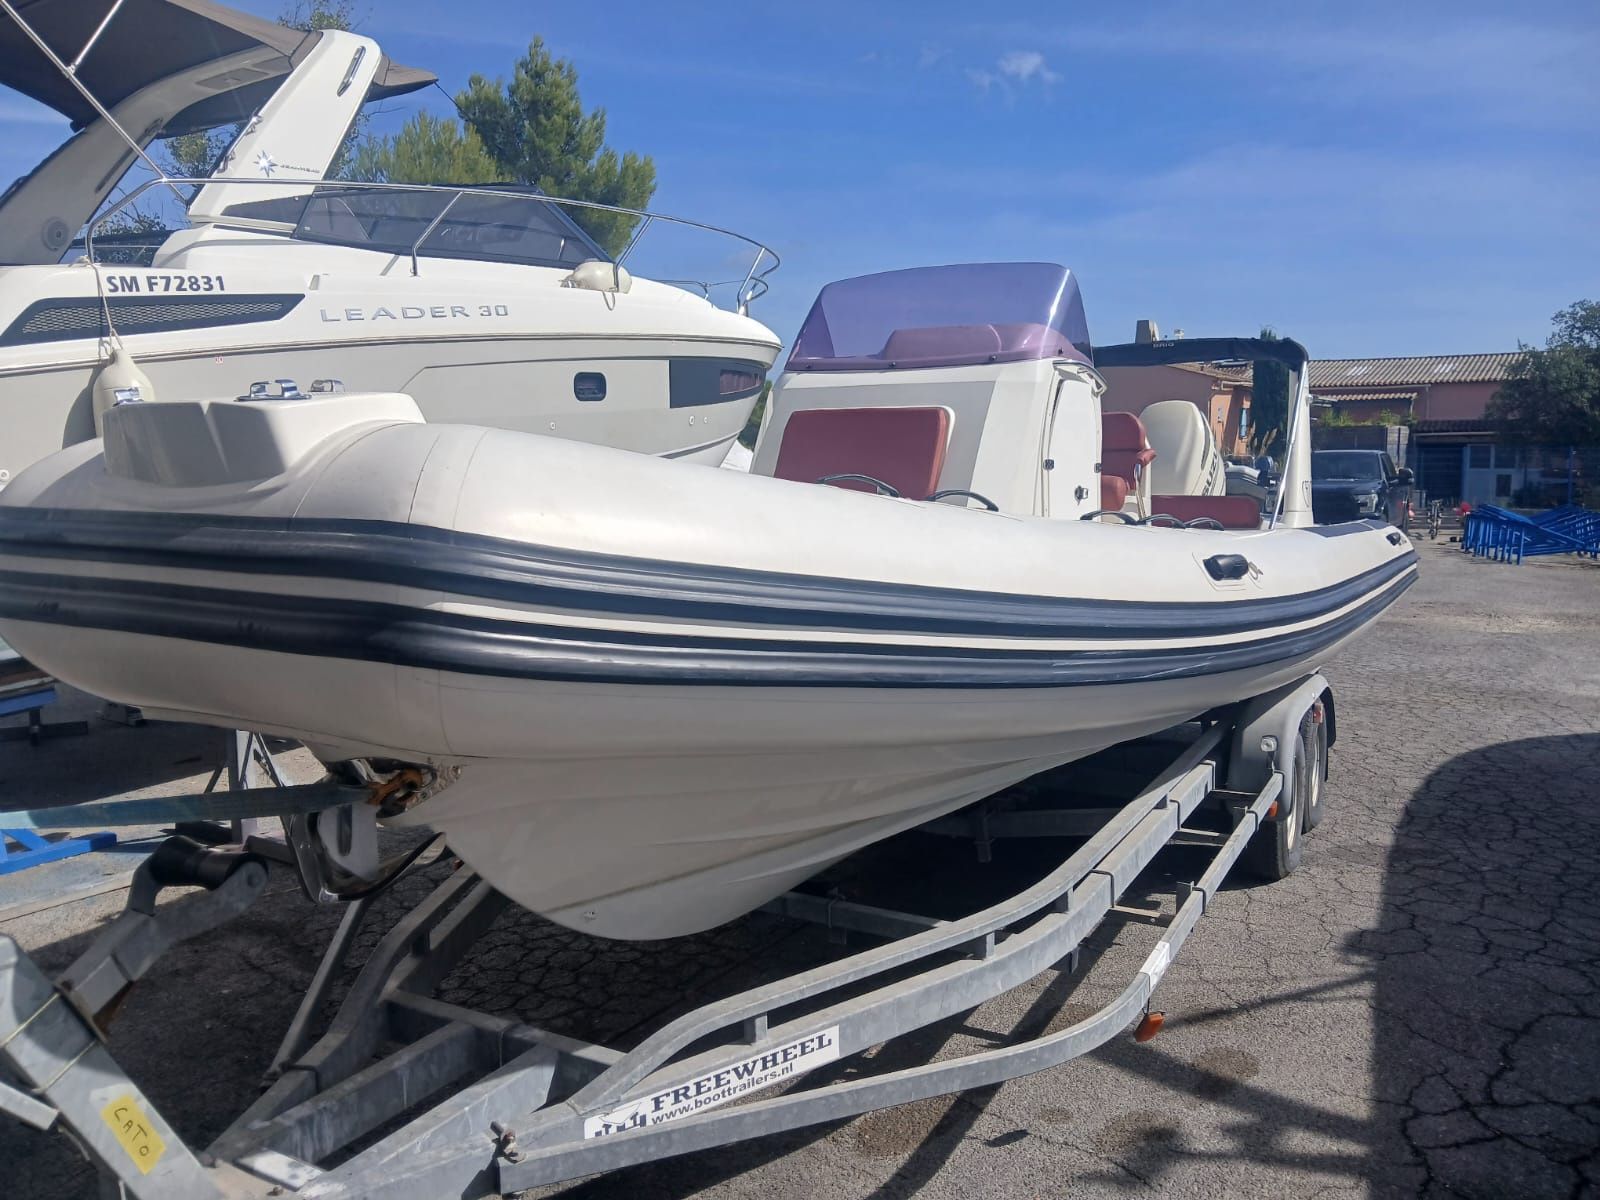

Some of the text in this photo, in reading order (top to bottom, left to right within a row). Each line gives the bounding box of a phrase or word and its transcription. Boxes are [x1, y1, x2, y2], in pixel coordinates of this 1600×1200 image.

[106, 275, 225, 292] SM F72831
[320, 305, 508, 322] LEADER 30
[651, 1033, 832, 1113] FREEWHEEL
[652, 1062, 793, 1125] www.boottrailers.nl
